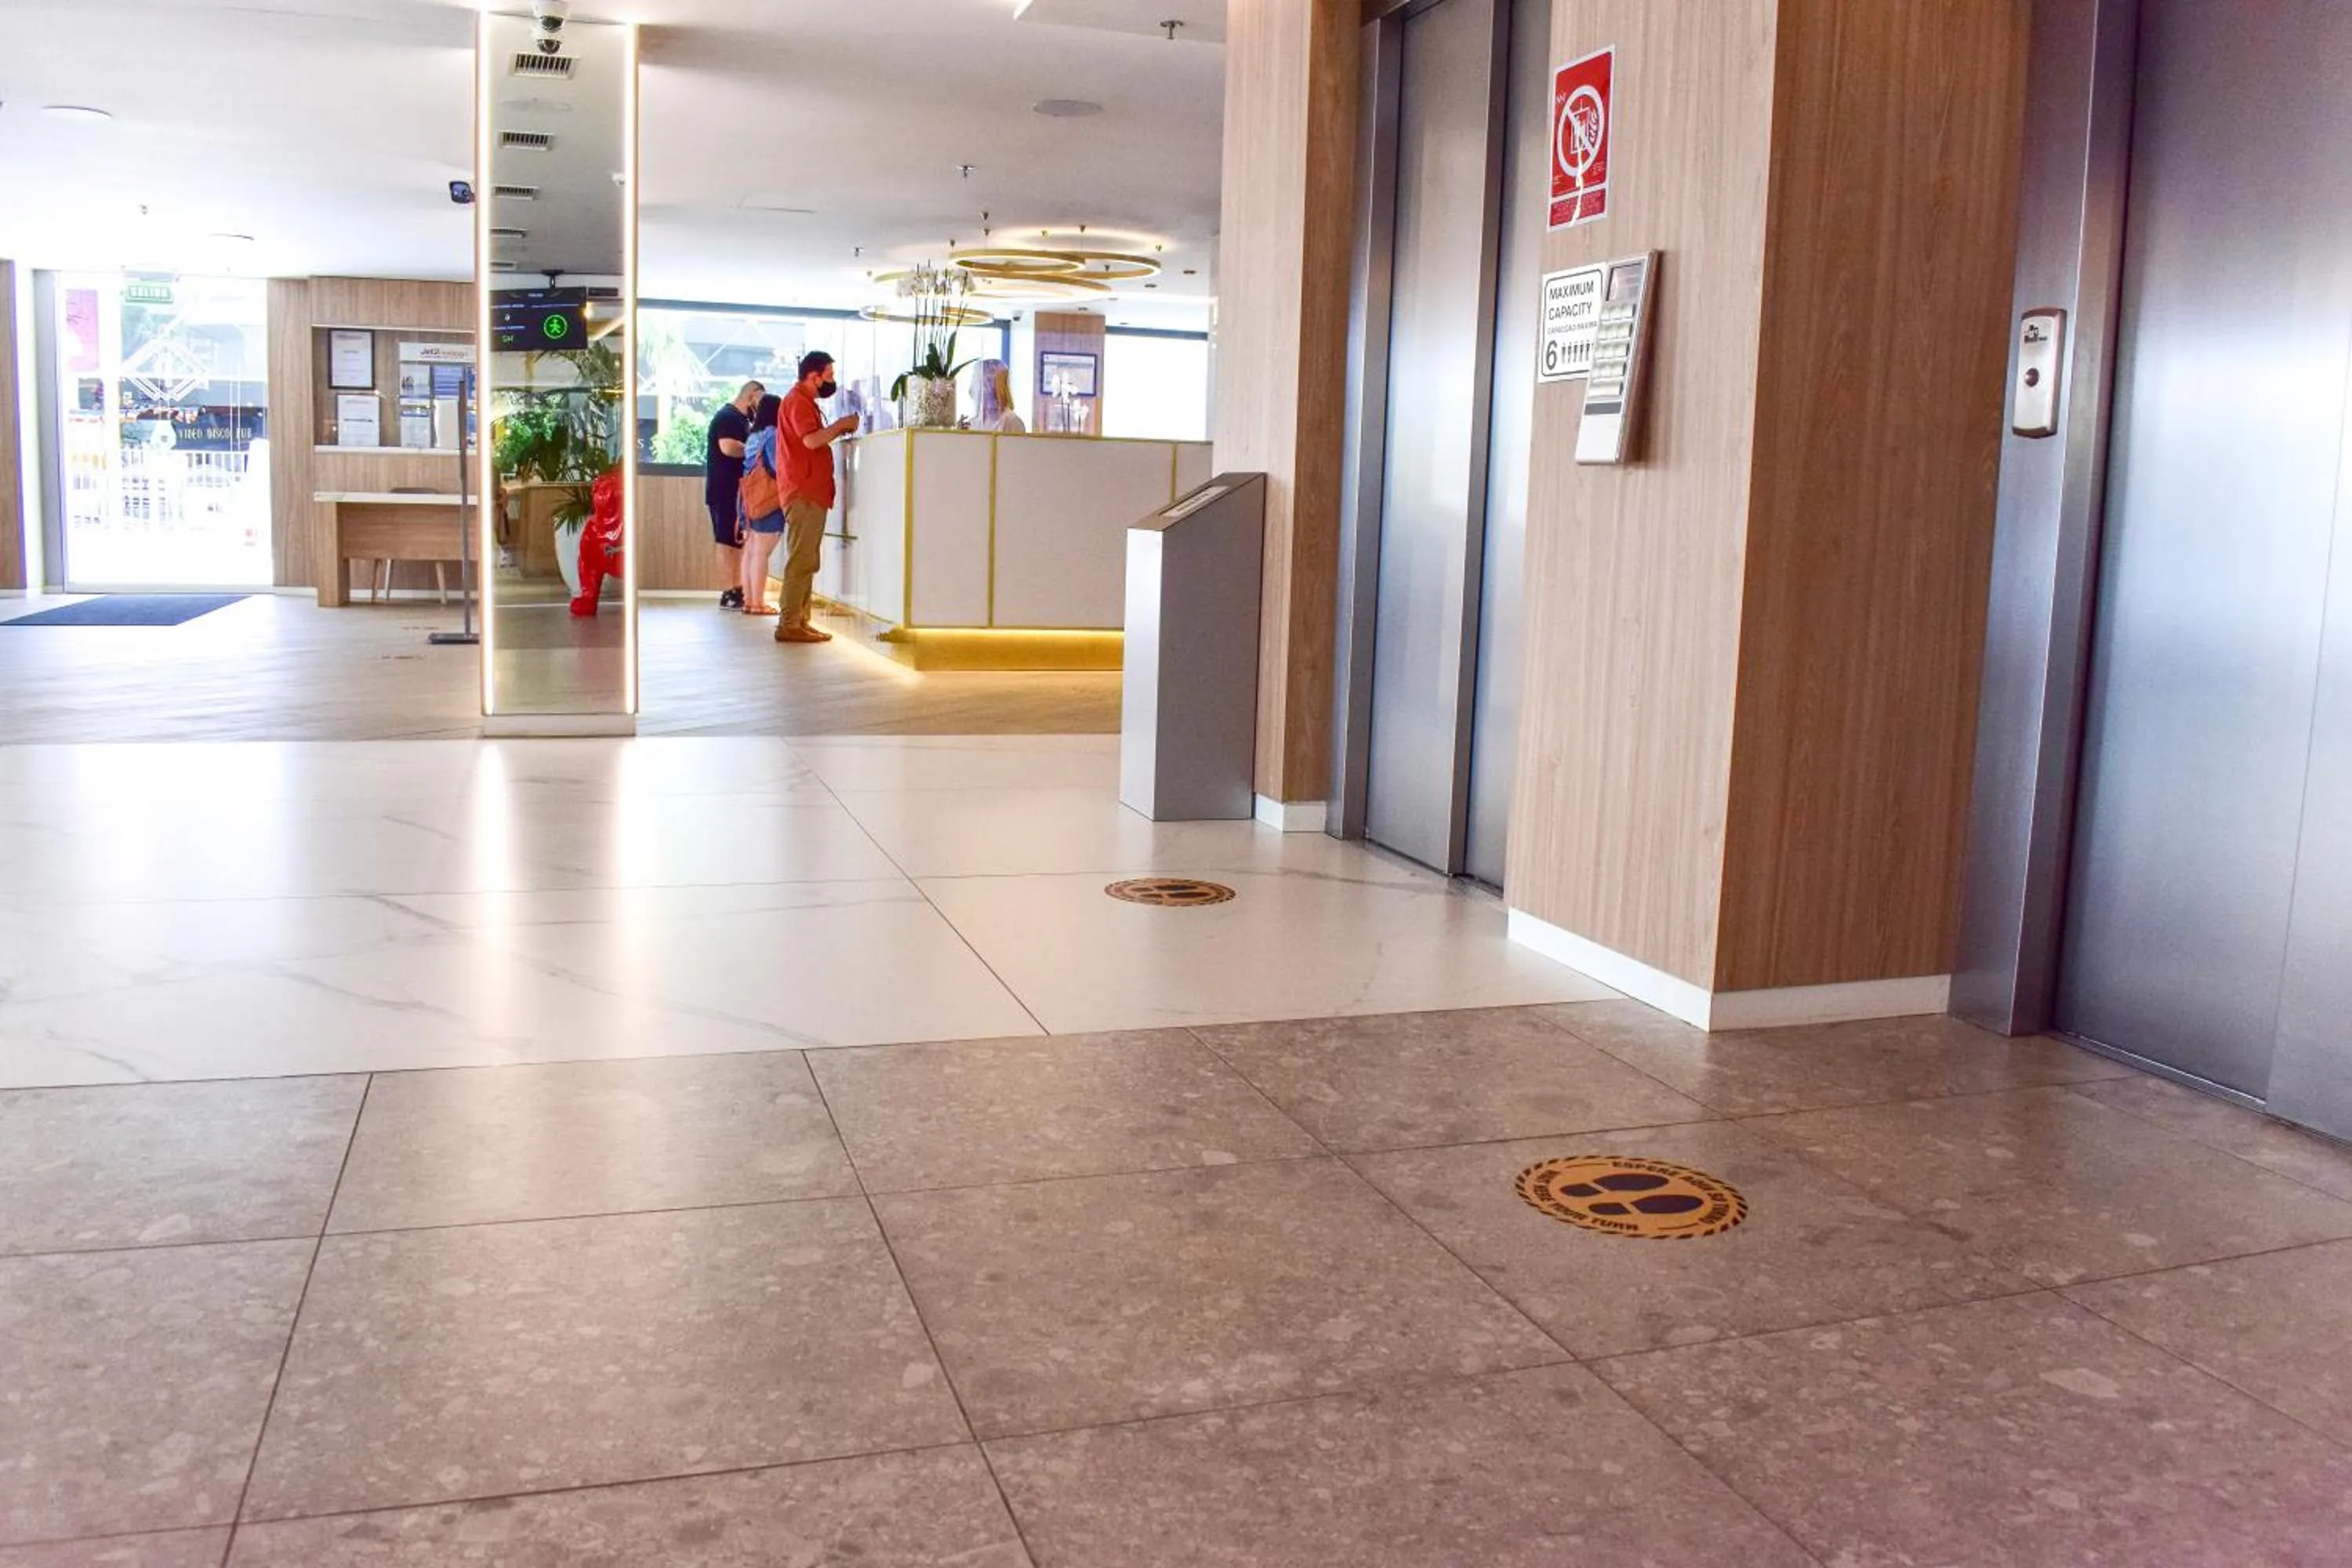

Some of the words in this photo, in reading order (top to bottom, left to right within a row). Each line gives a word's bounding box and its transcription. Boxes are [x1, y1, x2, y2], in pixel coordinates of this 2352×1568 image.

[1550, 280, 1594, 299] MAXIMUM
[1548, 301, 1592, 320] CAPACITY
[1546, 340, 1557, 370] 6
[1612, 1161, 1681, 1176] ESPERE
[1591, 1218, 1639, 1230] TURN
